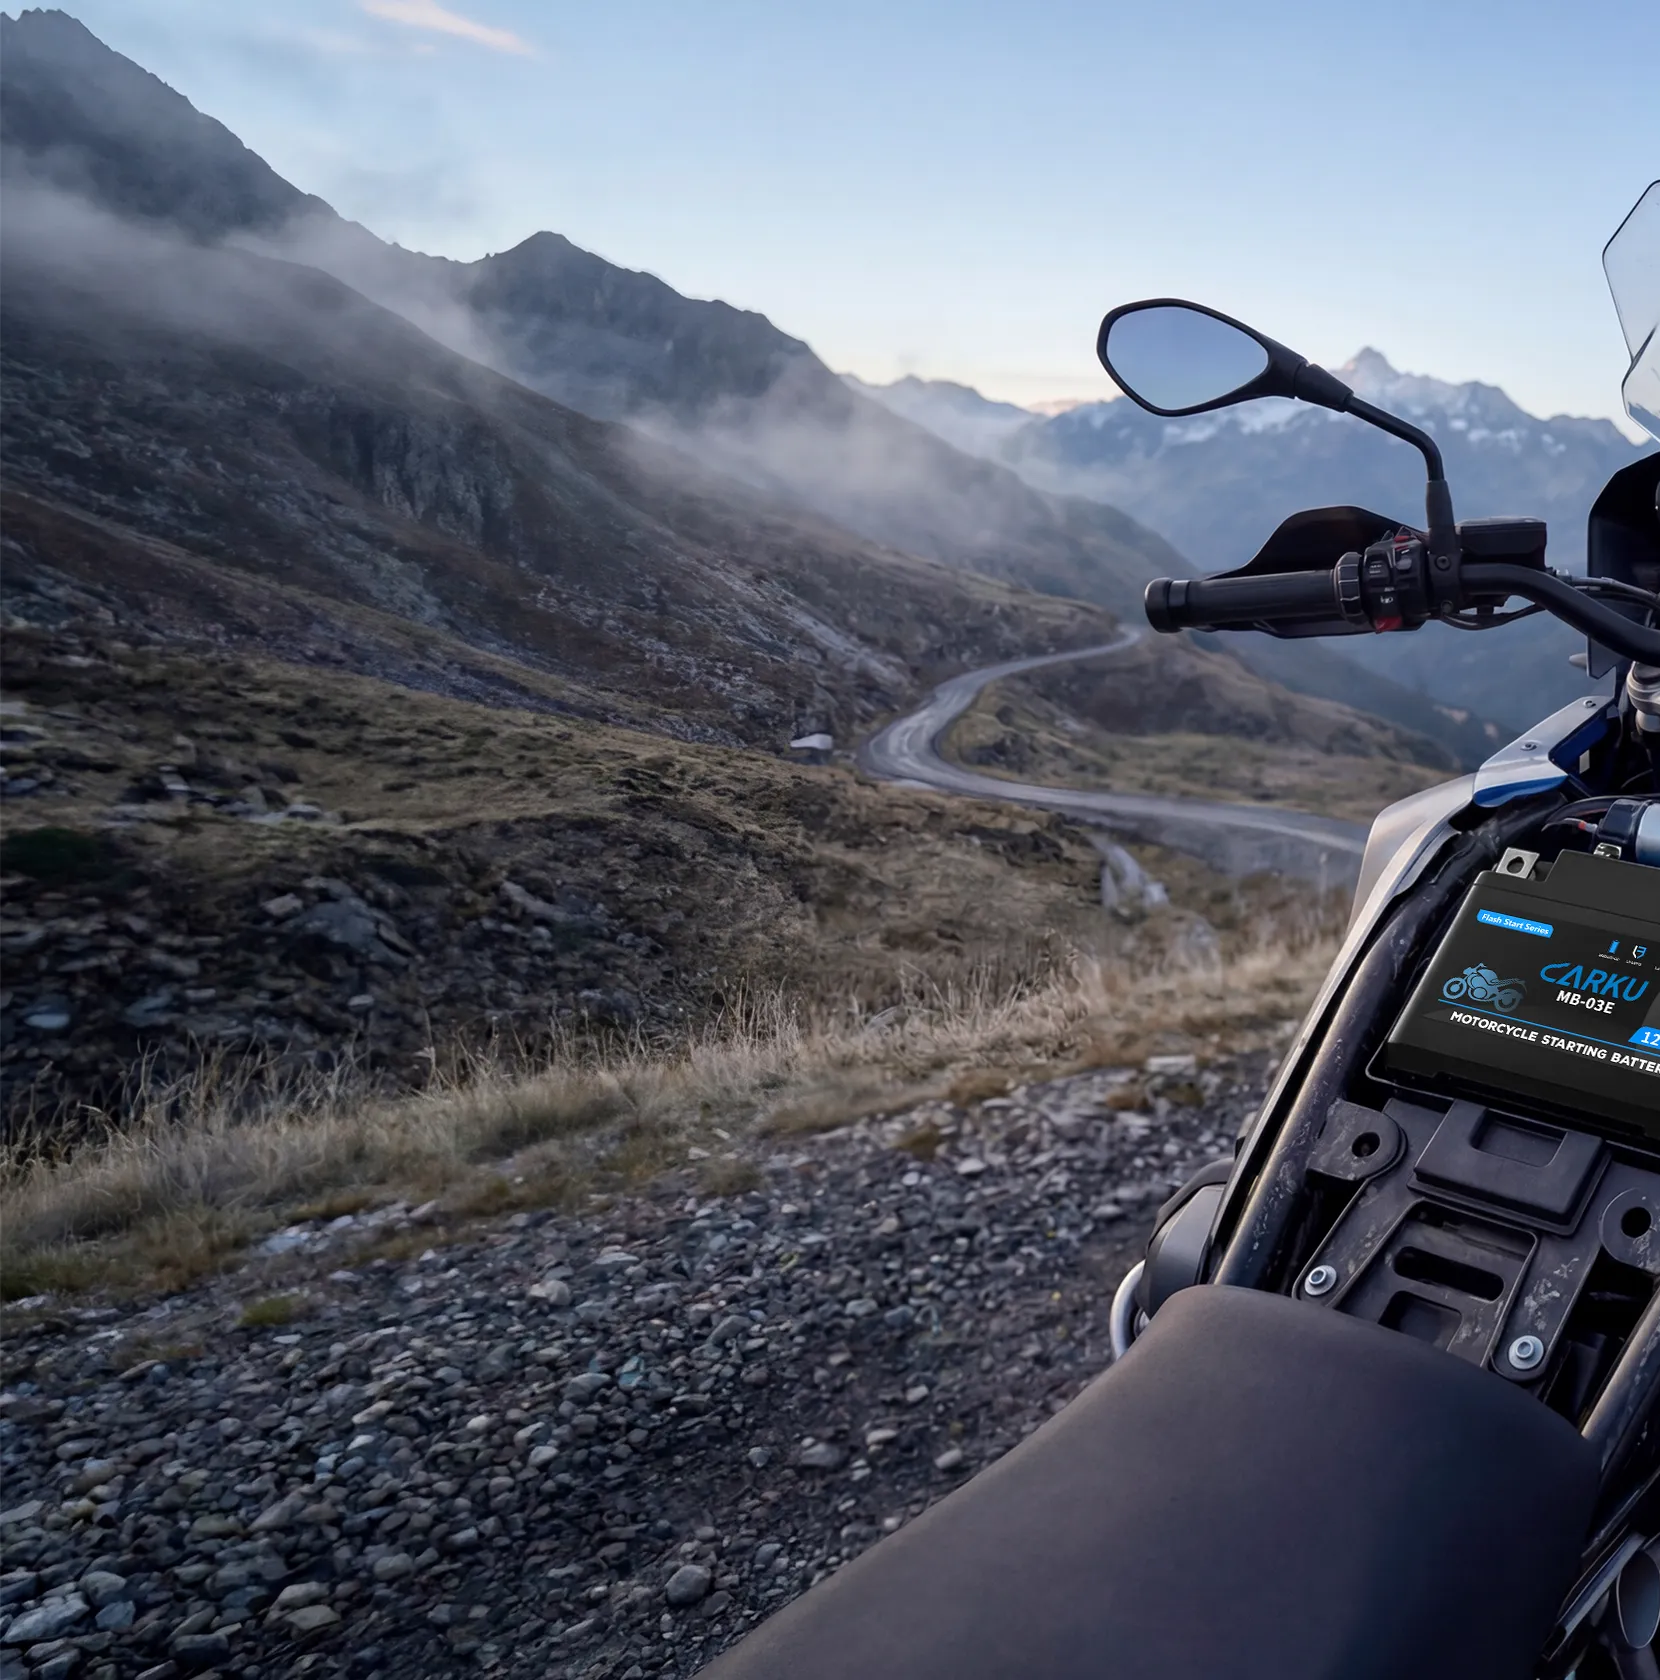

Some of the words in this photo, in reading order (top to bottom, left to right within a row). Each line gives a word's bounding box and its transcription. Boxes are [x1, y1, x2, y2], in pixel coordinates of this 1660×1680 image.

[1481, 913, 1502, 924] Flash
[1503, 918, 1524, 929] Start
[1524, 923, 1550, 935] Series
[1540, 962, 1650, 1002] CARKU
[1556, 990, 1616, 1015] MB-03E
[1450, 1011, 1539, 1043] MOTORCYCLE
[1541, 1034, 1608, 1060] STARTING
